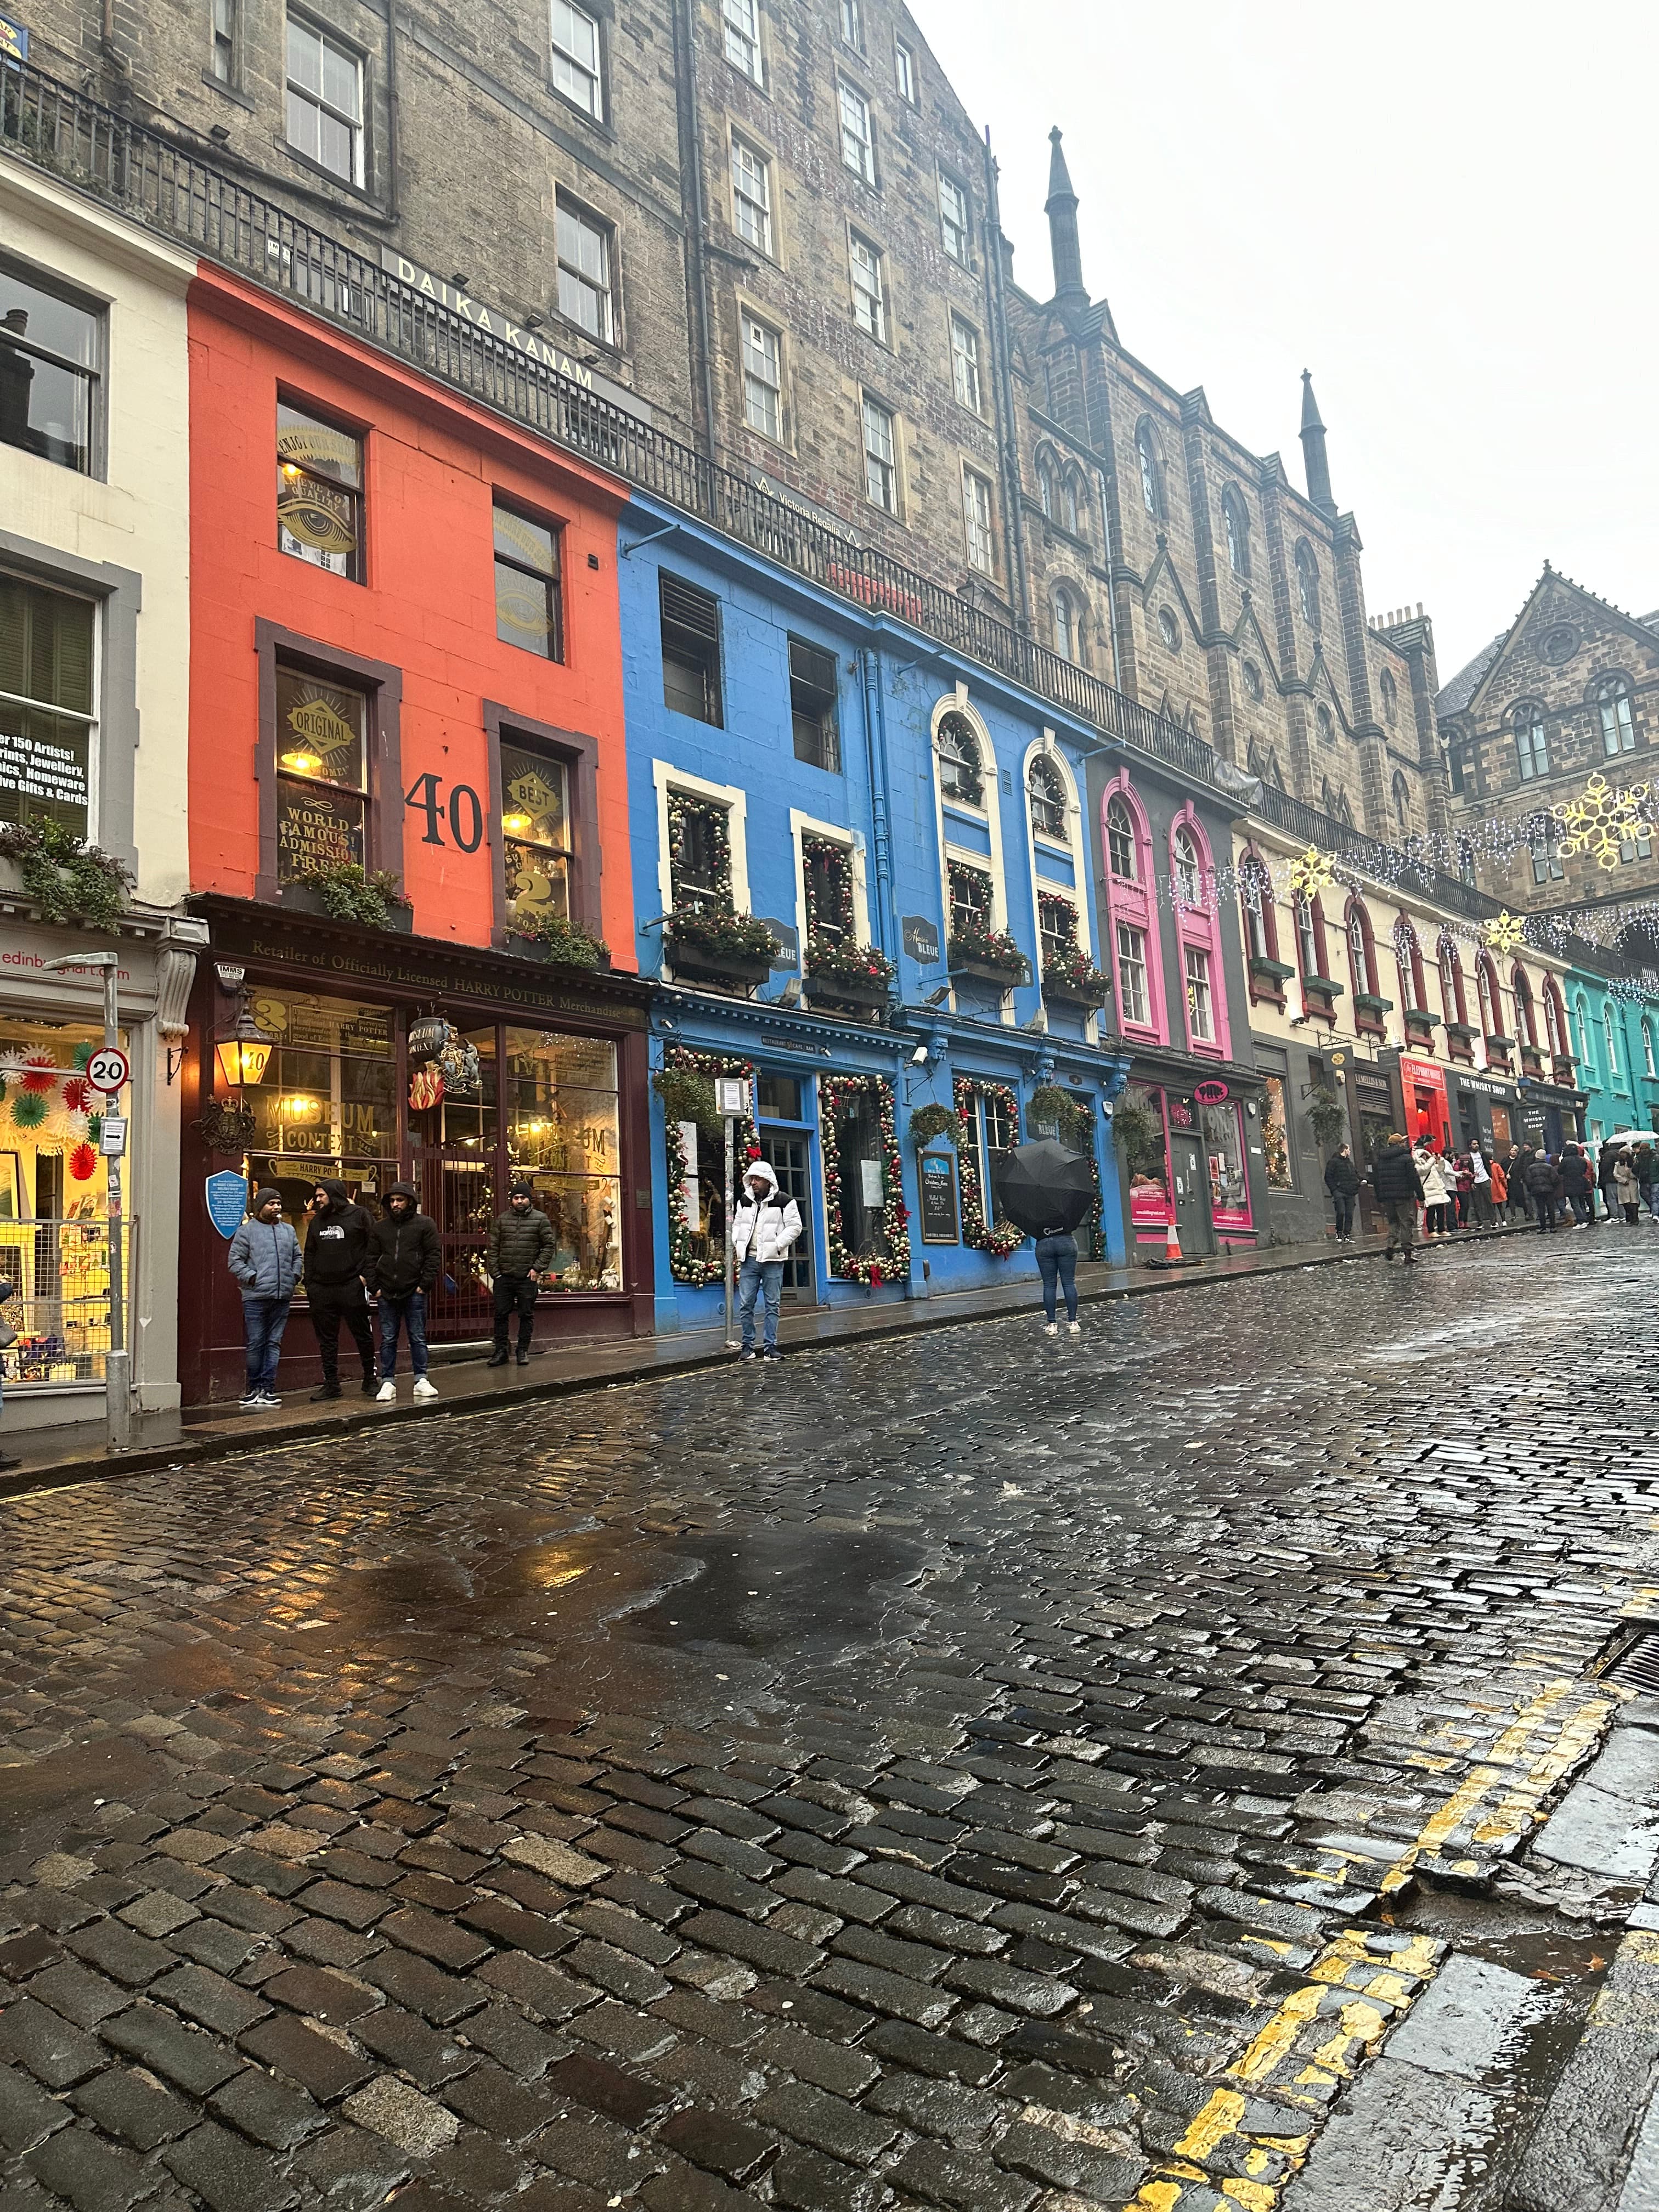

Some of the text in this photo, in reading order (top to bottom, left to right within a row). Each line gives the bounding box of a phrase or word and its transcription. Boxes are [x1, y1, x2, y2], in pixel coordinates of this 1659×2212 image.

[398, 256, 592, 391] DAIKA KANAM
[278, 435, 308, 454] ENJOY
[301, 478, 323, 493] EYE
[292, 486, 339, 511] QUALITY
[778, 492, 840, 537] Victoria Regalia
[296, 712, 347, 741] ORIGINAL
[12, 736, 32, 751] 150
[34, 741, 75, 761] Artists!
[30, 754, 84, 778] Jewellery,
[26, 767, 86, 792] Homeware
[18, 779, 44, 795] Gifts
[46, 787, 54, 798] &
[56, 788, 88, 806] Cards
[519, 785, 549, 806] BEST
[286, 806, 349, 832] WORLD
[404, 772, 483, 854] 40
[280, 820, 355, 848] FAMOUS!
[279, 836, 358, 863] ADMISSION
[291, 853, 338, 873] FRE
[516, 871, 554, 915] 2
[774, 946, 797, 961] LEUE
[918, 942, 939, 957] BLEUE
[220, 965, 242, 974] IMMS
[251, 940, 620, 1019] Retailer of Officially Licensed HARRY POTTER Merchandise
[255, 999, 287, 1032] 3
[329, 1021, 355, 1031] HARRY
[359, 1026, 387, 1036] POTTER
[93, 1060, 122, 1080] 20
[1459, 1076, 1506, 1096] THE WHISKY SHOP
[266, 1095, 374, 1132] MUSEUM
[286, 1130, 355, 1151] CONTEXT
[300, 1163, 321, 1174] HARRY
